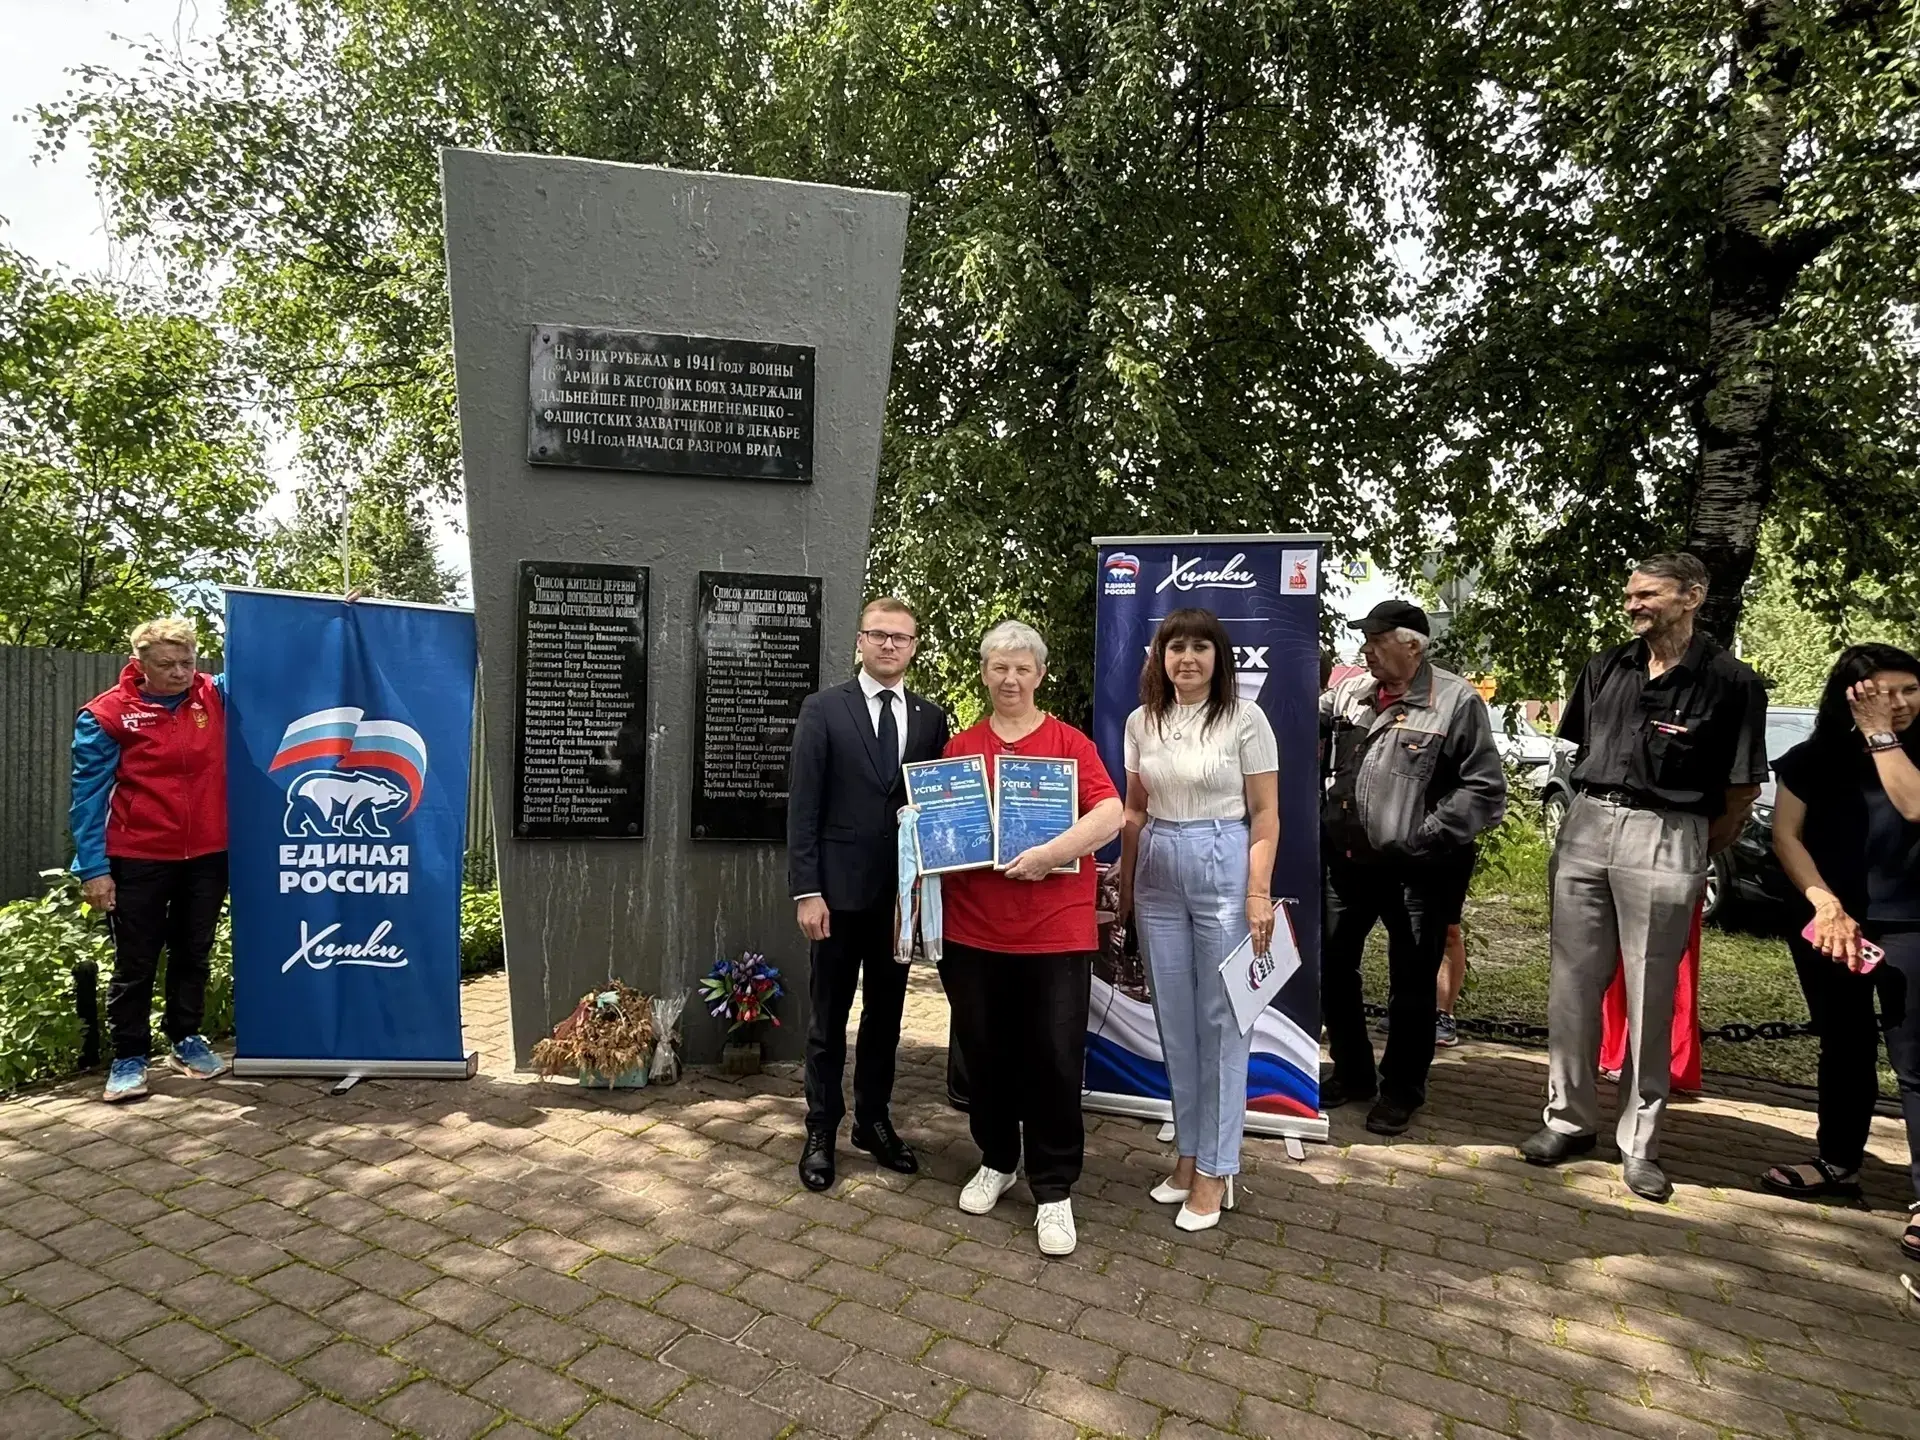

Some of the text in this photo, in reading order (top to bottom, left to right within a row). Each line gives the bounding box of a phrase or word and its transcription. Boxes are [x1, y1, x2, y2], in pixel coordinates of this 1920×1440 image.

[554, 344, 572, 360] НА
[576, 348, 607, 362] ЭТИХ
[610, 352, 668, 367] РУБЕЖАХ
[687, 355, 715, 371] 1941
[750, 362, 793, 377] ВОИНЫ
[564, 371, 609, 386] АРМИИ
[613, 374, 620, 386] В
[624, 375, 692, 391] ЖЕСТОКИХ
[696, 380, 726, 394] БОЯХ
[729, 383, 802, 400] ЗАДЕРЖАЛИ
[540, 389, 626, 407] ДАЛЬНЕЙШЕЕ
[630, 395, 724, 414] ПРОДВИЖЕНИЕ
[544, 409, 800, 439] ФАШИСТСКИХ ЗАХВАТЧИКОВ И В ДЕКАБРЕ
[566, 428, 595, 444] 1941
[628, 435, 683, 450] НАЧАЛСЯ
[688, 439, 741, 454] РАЗГРОМ
[747, 443, 782, 457] ВРАГА
[1156, 553, 1257, 593] Химки
[566, 578, 601, 590] ЖИТЕЛЕЙ
[603, 580, 636, 592] ДЕРЕВНИ
[567, 591, 602, 603] ПОГИБШИХ
[604, 593, 612, 604] ВО
[614, 594, 634, 605] ВРЕМЯ
[744, 589, 777, 600] ЖИТЕЛЕЙ
[779, 591, 808, 602] СОВХОЗА
[778, 604, 785, 613] ВО
[787, 604, 805, 615] ВРЕМЯ
[564, 661, 581, 670] Петр
[567, 719, 582, 728] Егор
[552, 738, 575, 747] Сергей
[561, 767, 584, 776] Сергей
[914, 785, 943, 794] УСПЕХ
[555, 795, 570, 805] Егор
[553, 805, 569, 815] Егор
[280, 844, 408, 868] ЕДИНАЯ
[280, 871, 408, 894] РОССИЯ
[282, 920, 408, 973] Химки
